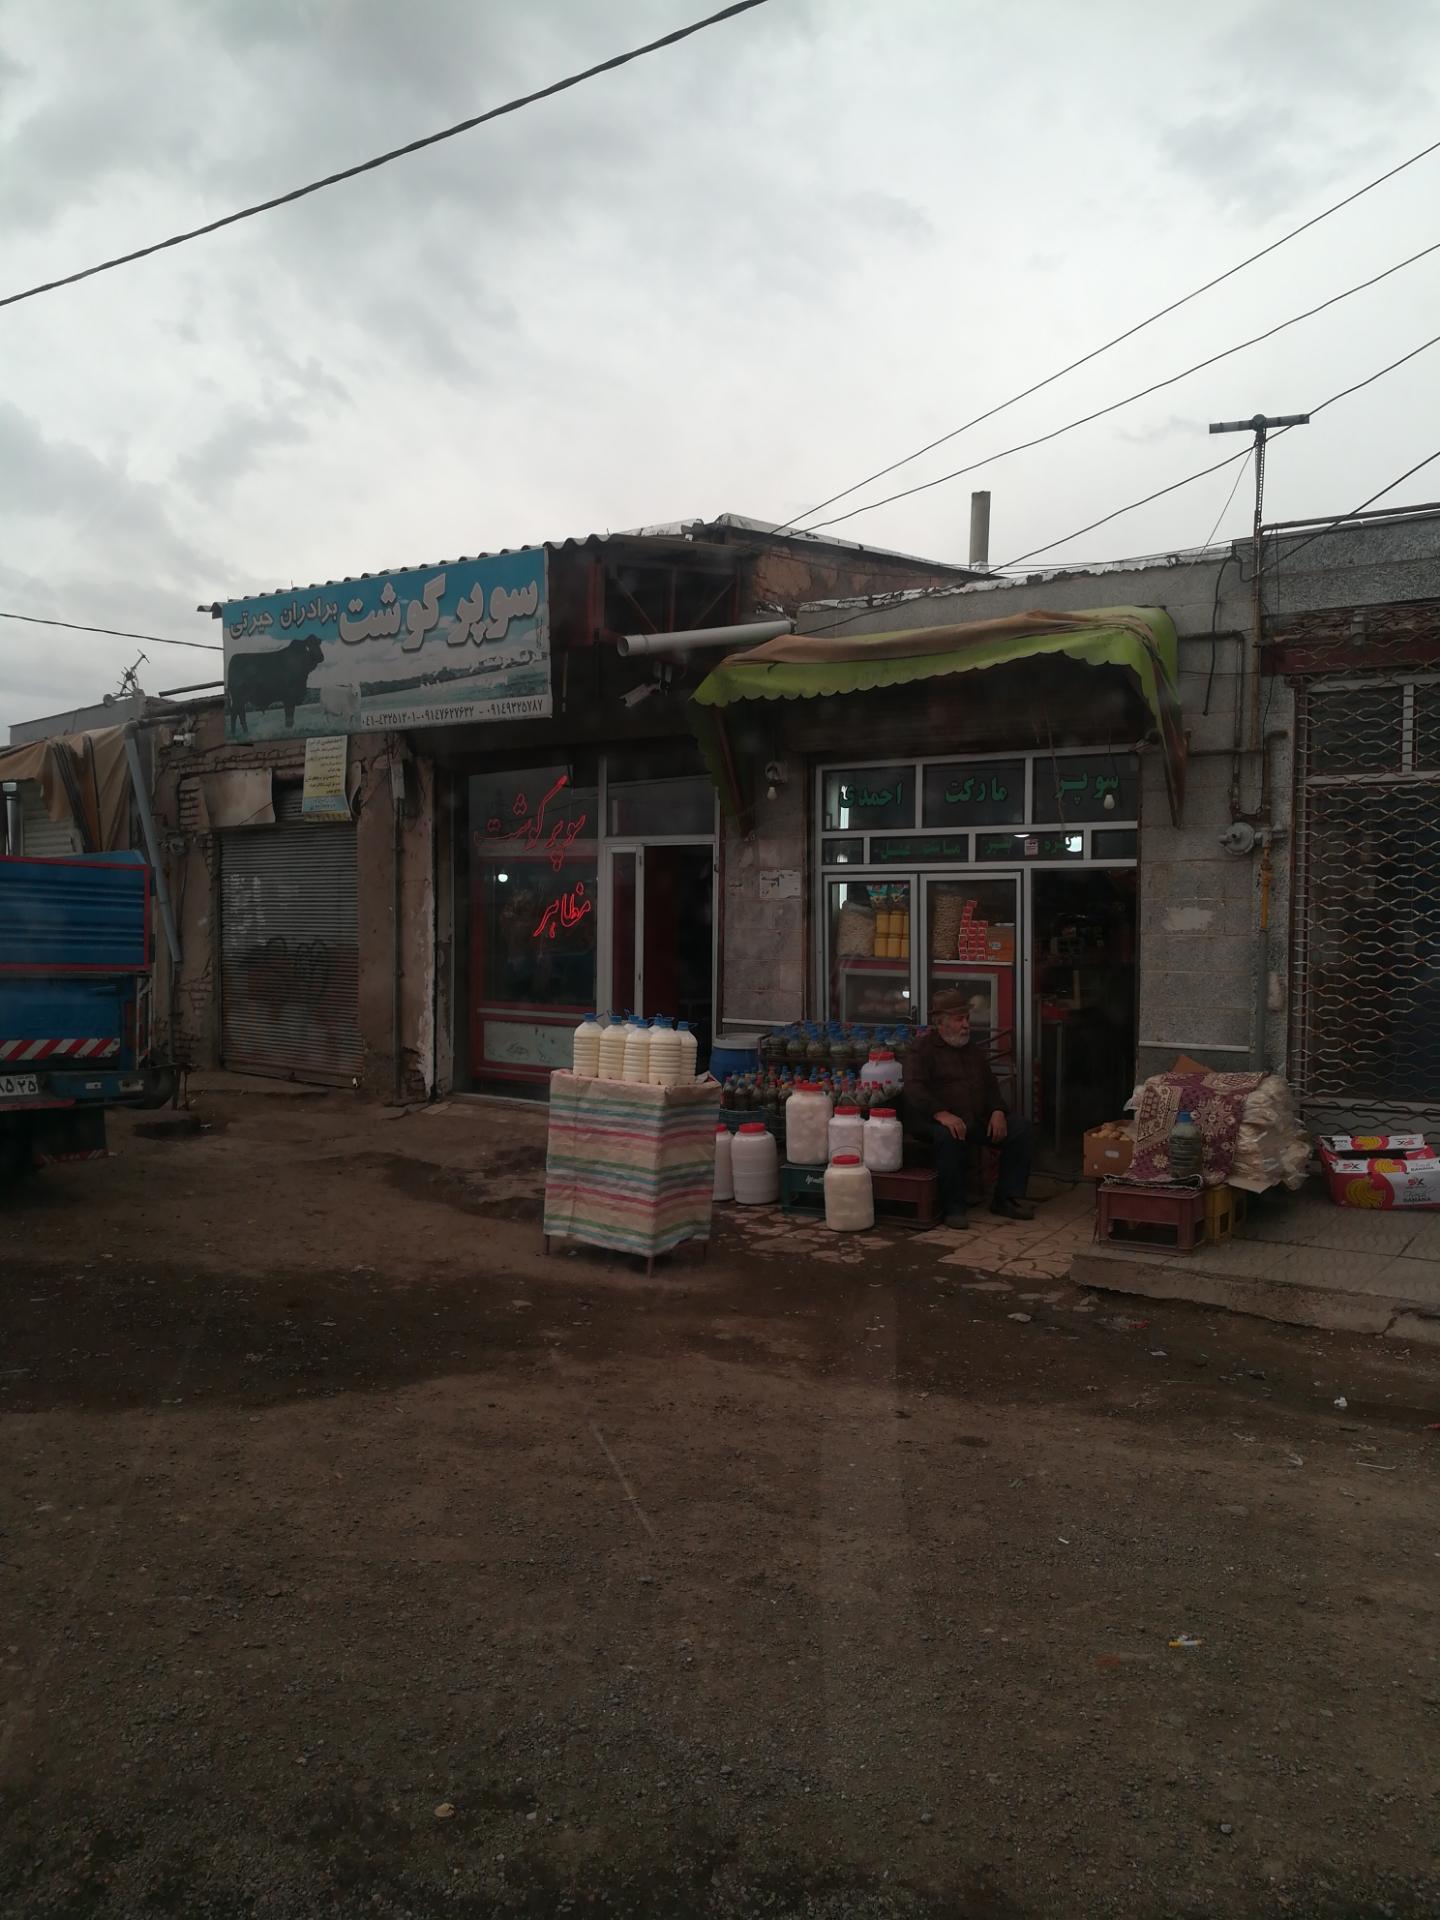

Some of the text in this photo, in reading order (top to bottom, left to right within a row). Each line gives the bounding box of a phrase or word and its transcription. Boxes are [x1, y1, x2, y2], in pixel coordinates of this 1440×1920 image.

[280, 598, 339, 629] برادران
[339, 573, 447, 651] گوشت
[446, 579, 539, 646] سوپر
[838, 782, 903, 808] احمدی
[943, 775, 1009, 803] مارکت
[473, 774, 587, 872] سوپر گوشت
